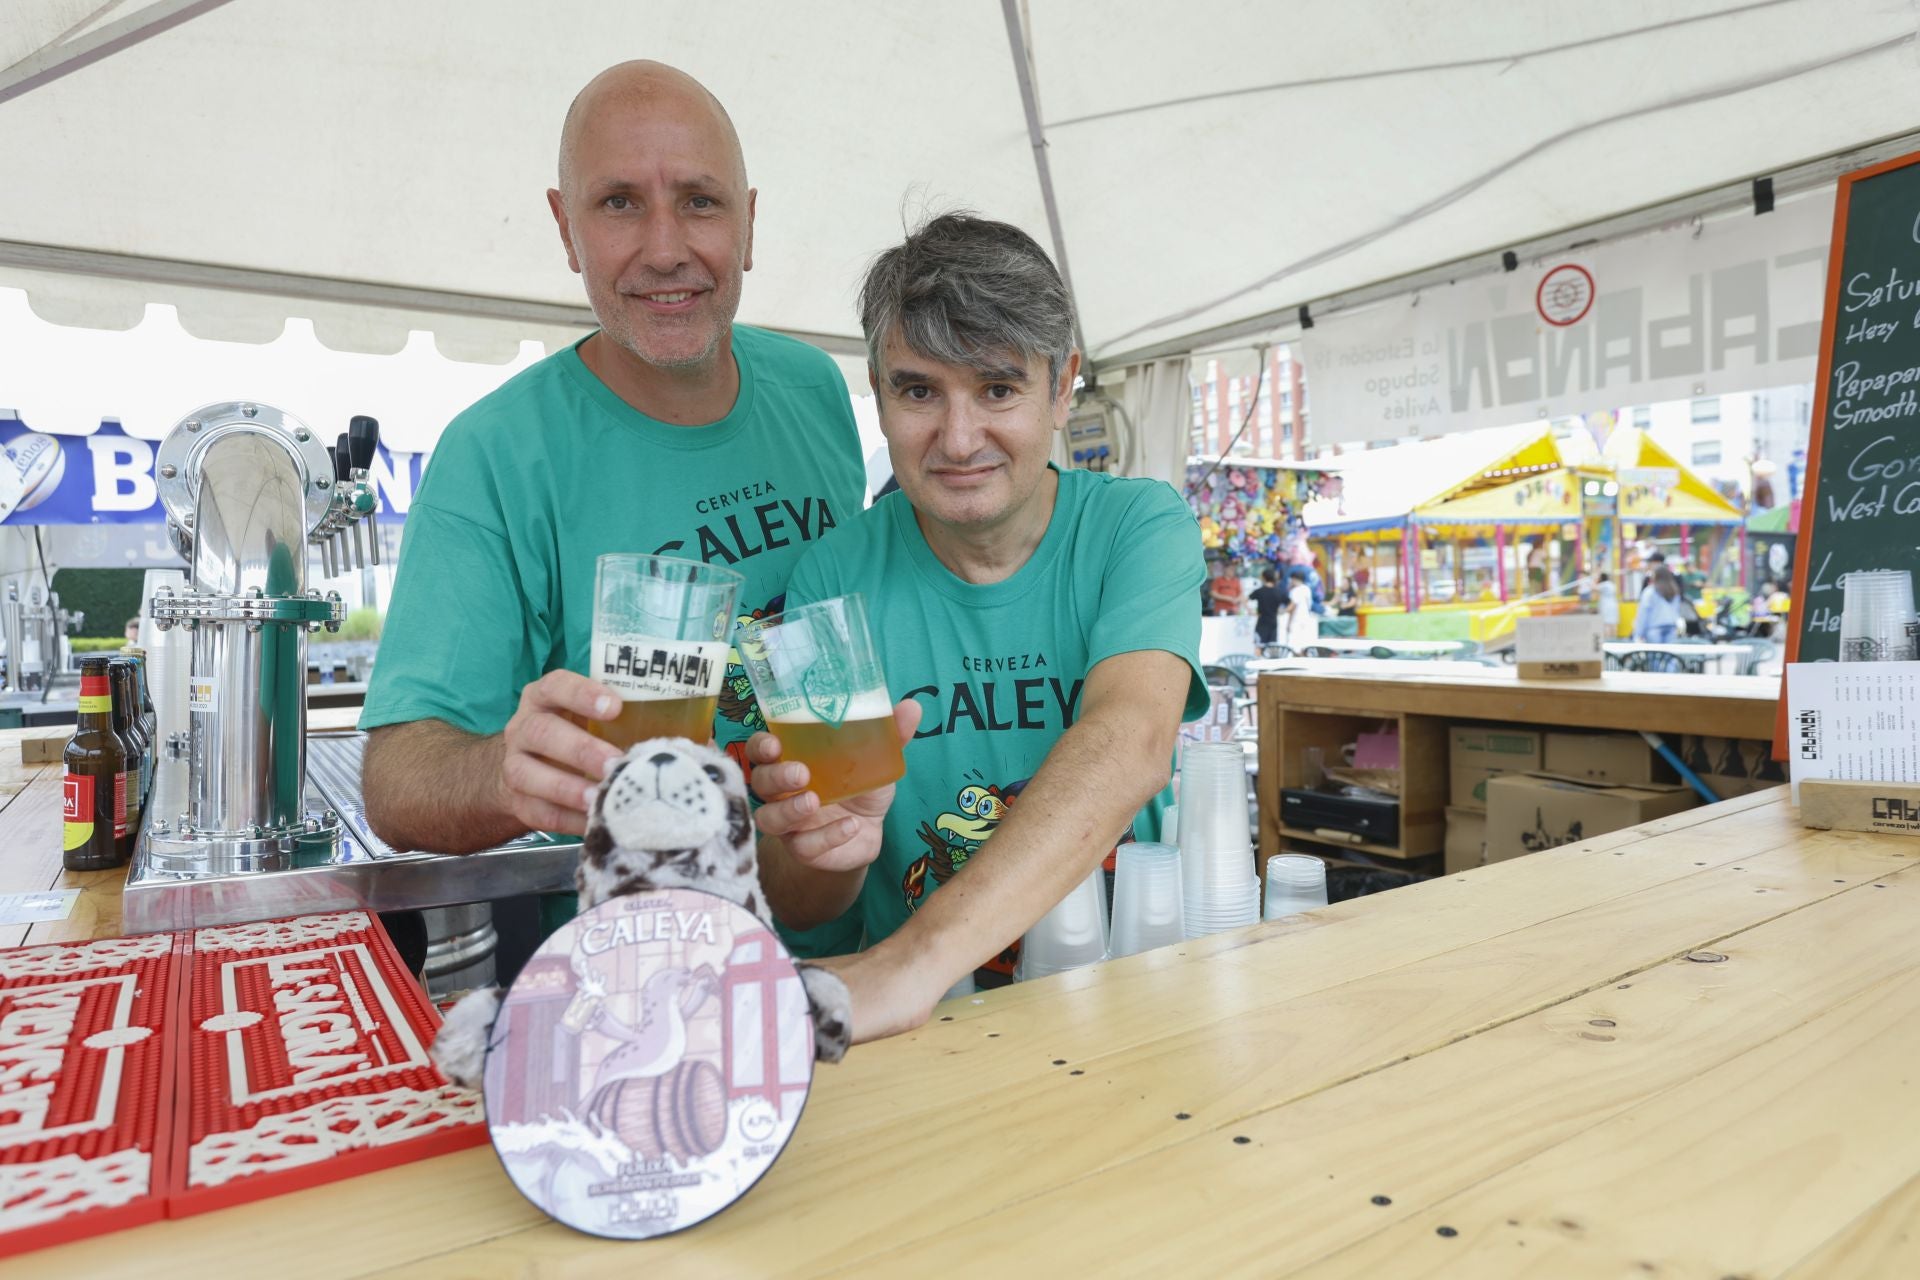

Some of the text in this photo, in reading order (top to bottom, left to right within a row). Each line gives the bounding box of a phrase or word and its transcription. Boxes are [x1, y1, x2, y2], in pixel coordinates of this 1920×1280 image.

[1845, 318, 1899, 345] Hazy
[696, 480, 776, 514] CERVEZA
[1828, 484, 1887, 522] West
[962, 652, 1047, 673] CERVEZA
[899, 677, 1084, 739] CALEY
[581, 911, 716, 956] CALEYA
